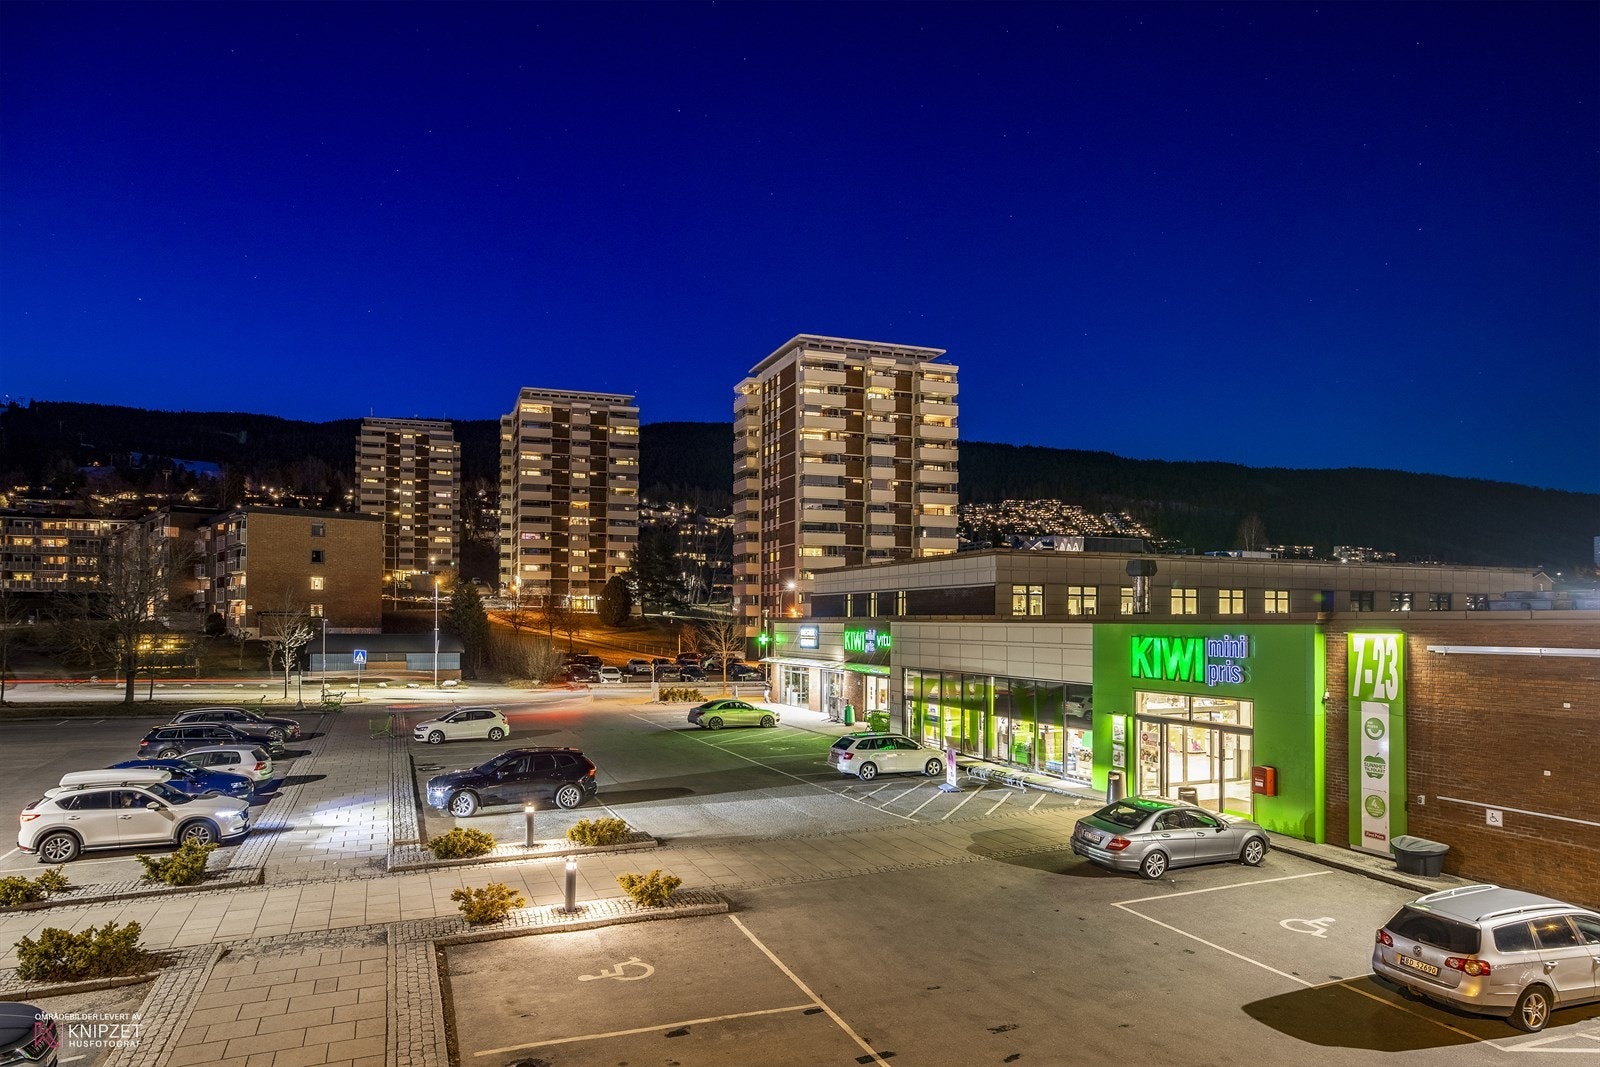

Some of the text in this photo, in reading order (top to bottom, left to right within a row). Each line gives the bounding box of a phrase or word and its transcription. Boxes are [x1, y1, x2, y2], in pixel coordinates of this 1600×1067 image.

[844, 631, 865, 651] KIWI
[1207, 634, 1246, 659] mini
[1131, 636, 1206, 683] KIWI
[1352, 635, 1399, 700] 7-23
[1207, 660, 1242, 687] pris
